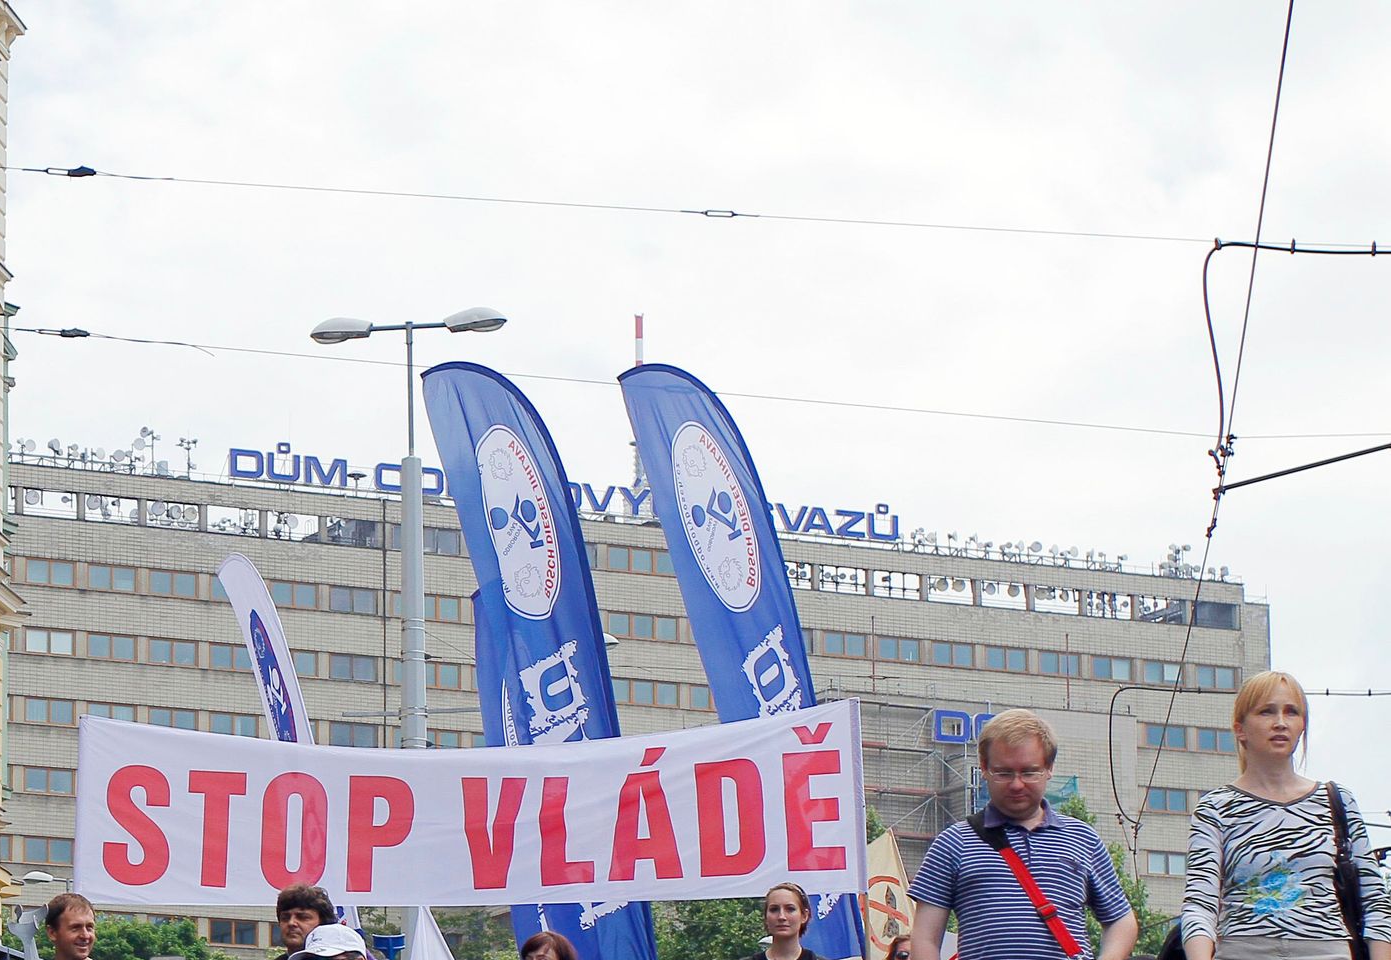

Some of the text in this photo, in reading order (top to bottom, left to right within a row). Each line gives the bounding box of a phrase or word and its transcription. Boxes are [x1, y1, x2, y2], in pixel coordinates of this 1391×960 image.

[229, 442, 348, 487] DŮM
[767, 503, 899, 541] VAZŮ
[103, 764, 415, 893] STOP
[462, 722, 847, 890] VLÁDĚ
